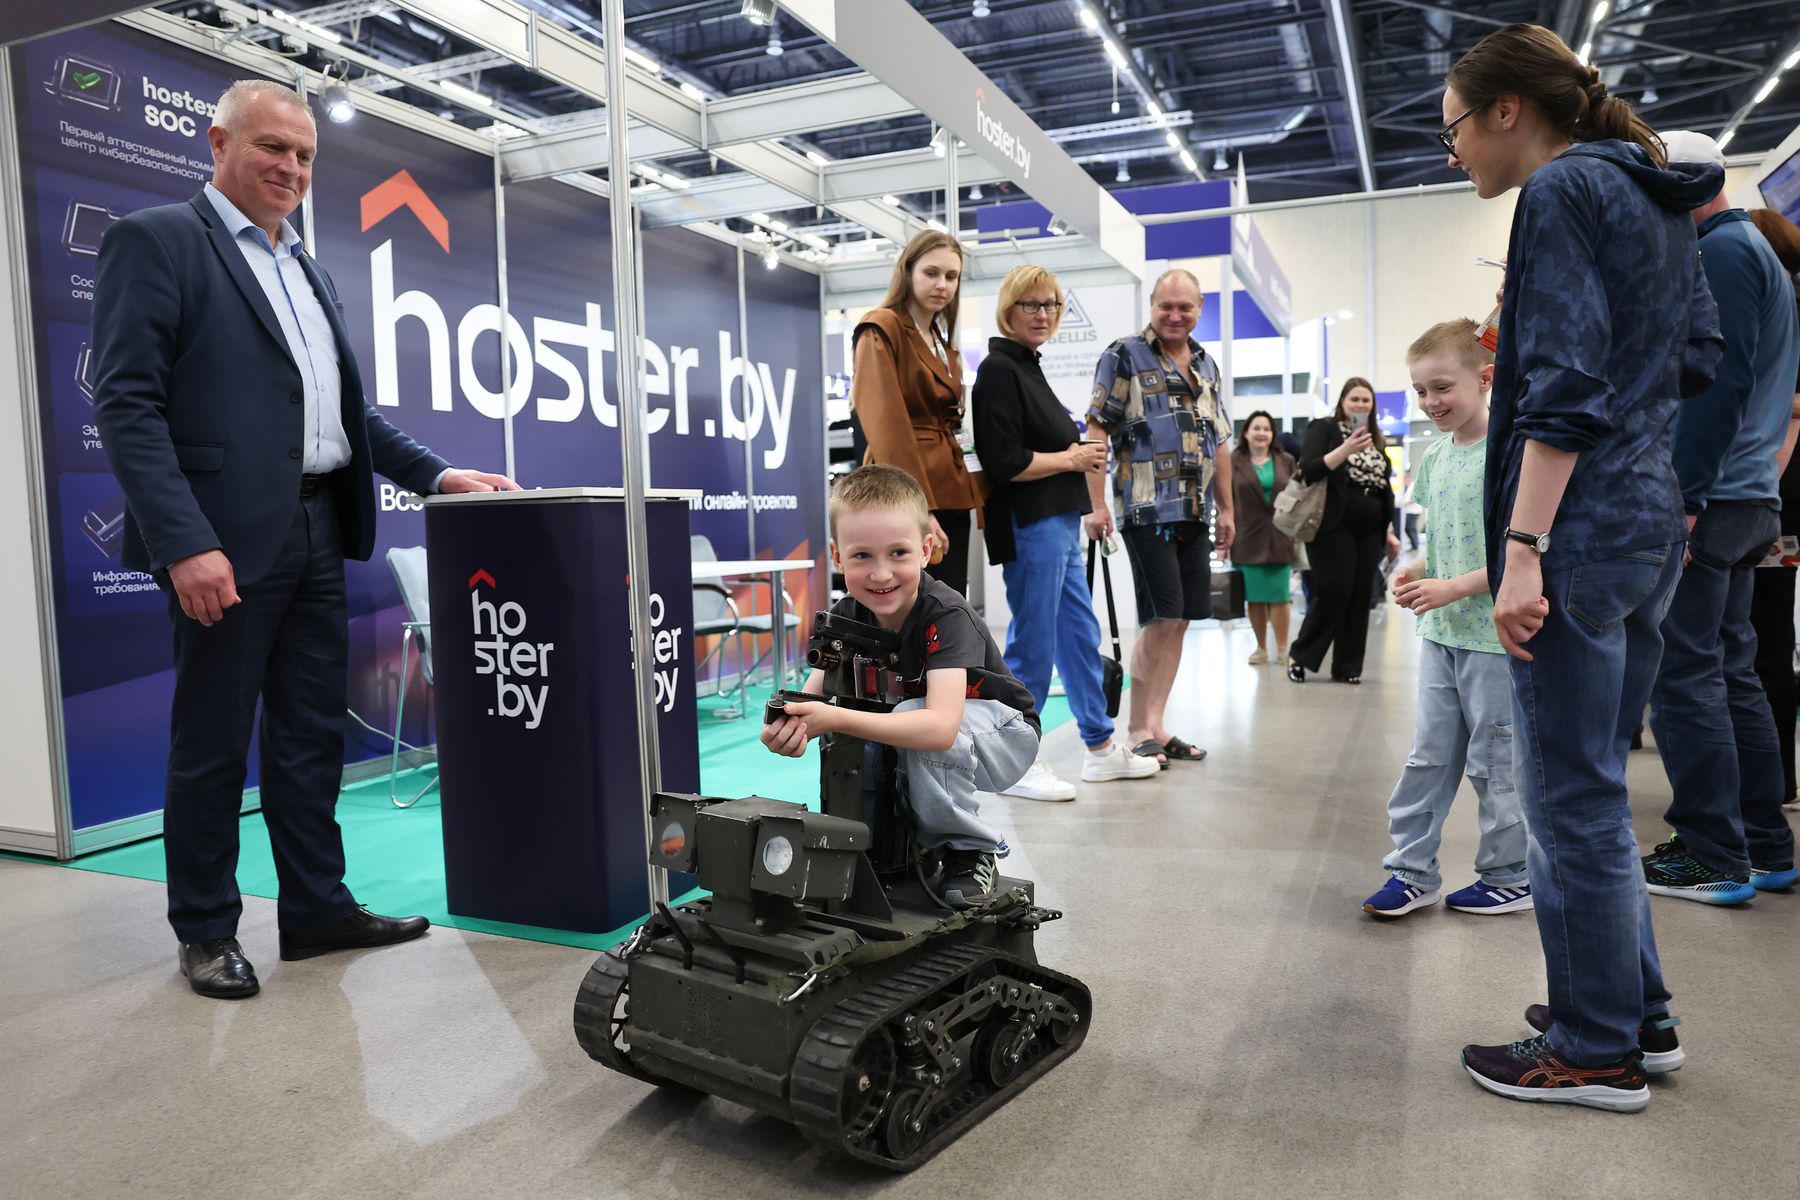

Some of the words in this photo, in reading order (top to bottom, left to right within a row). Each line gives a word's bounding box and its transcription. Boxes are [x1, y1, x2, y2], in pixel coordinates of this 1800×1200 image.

[60, 120, 105, 143] Первый
[107, 135, 187, 165] аттестованный
[144, 104, 196, 138] SOC
[977, 100, 1031, 178] hoster.by
[61, 136, 97, 154] центр
[98, 145, 204, 182] кибербезопасности
